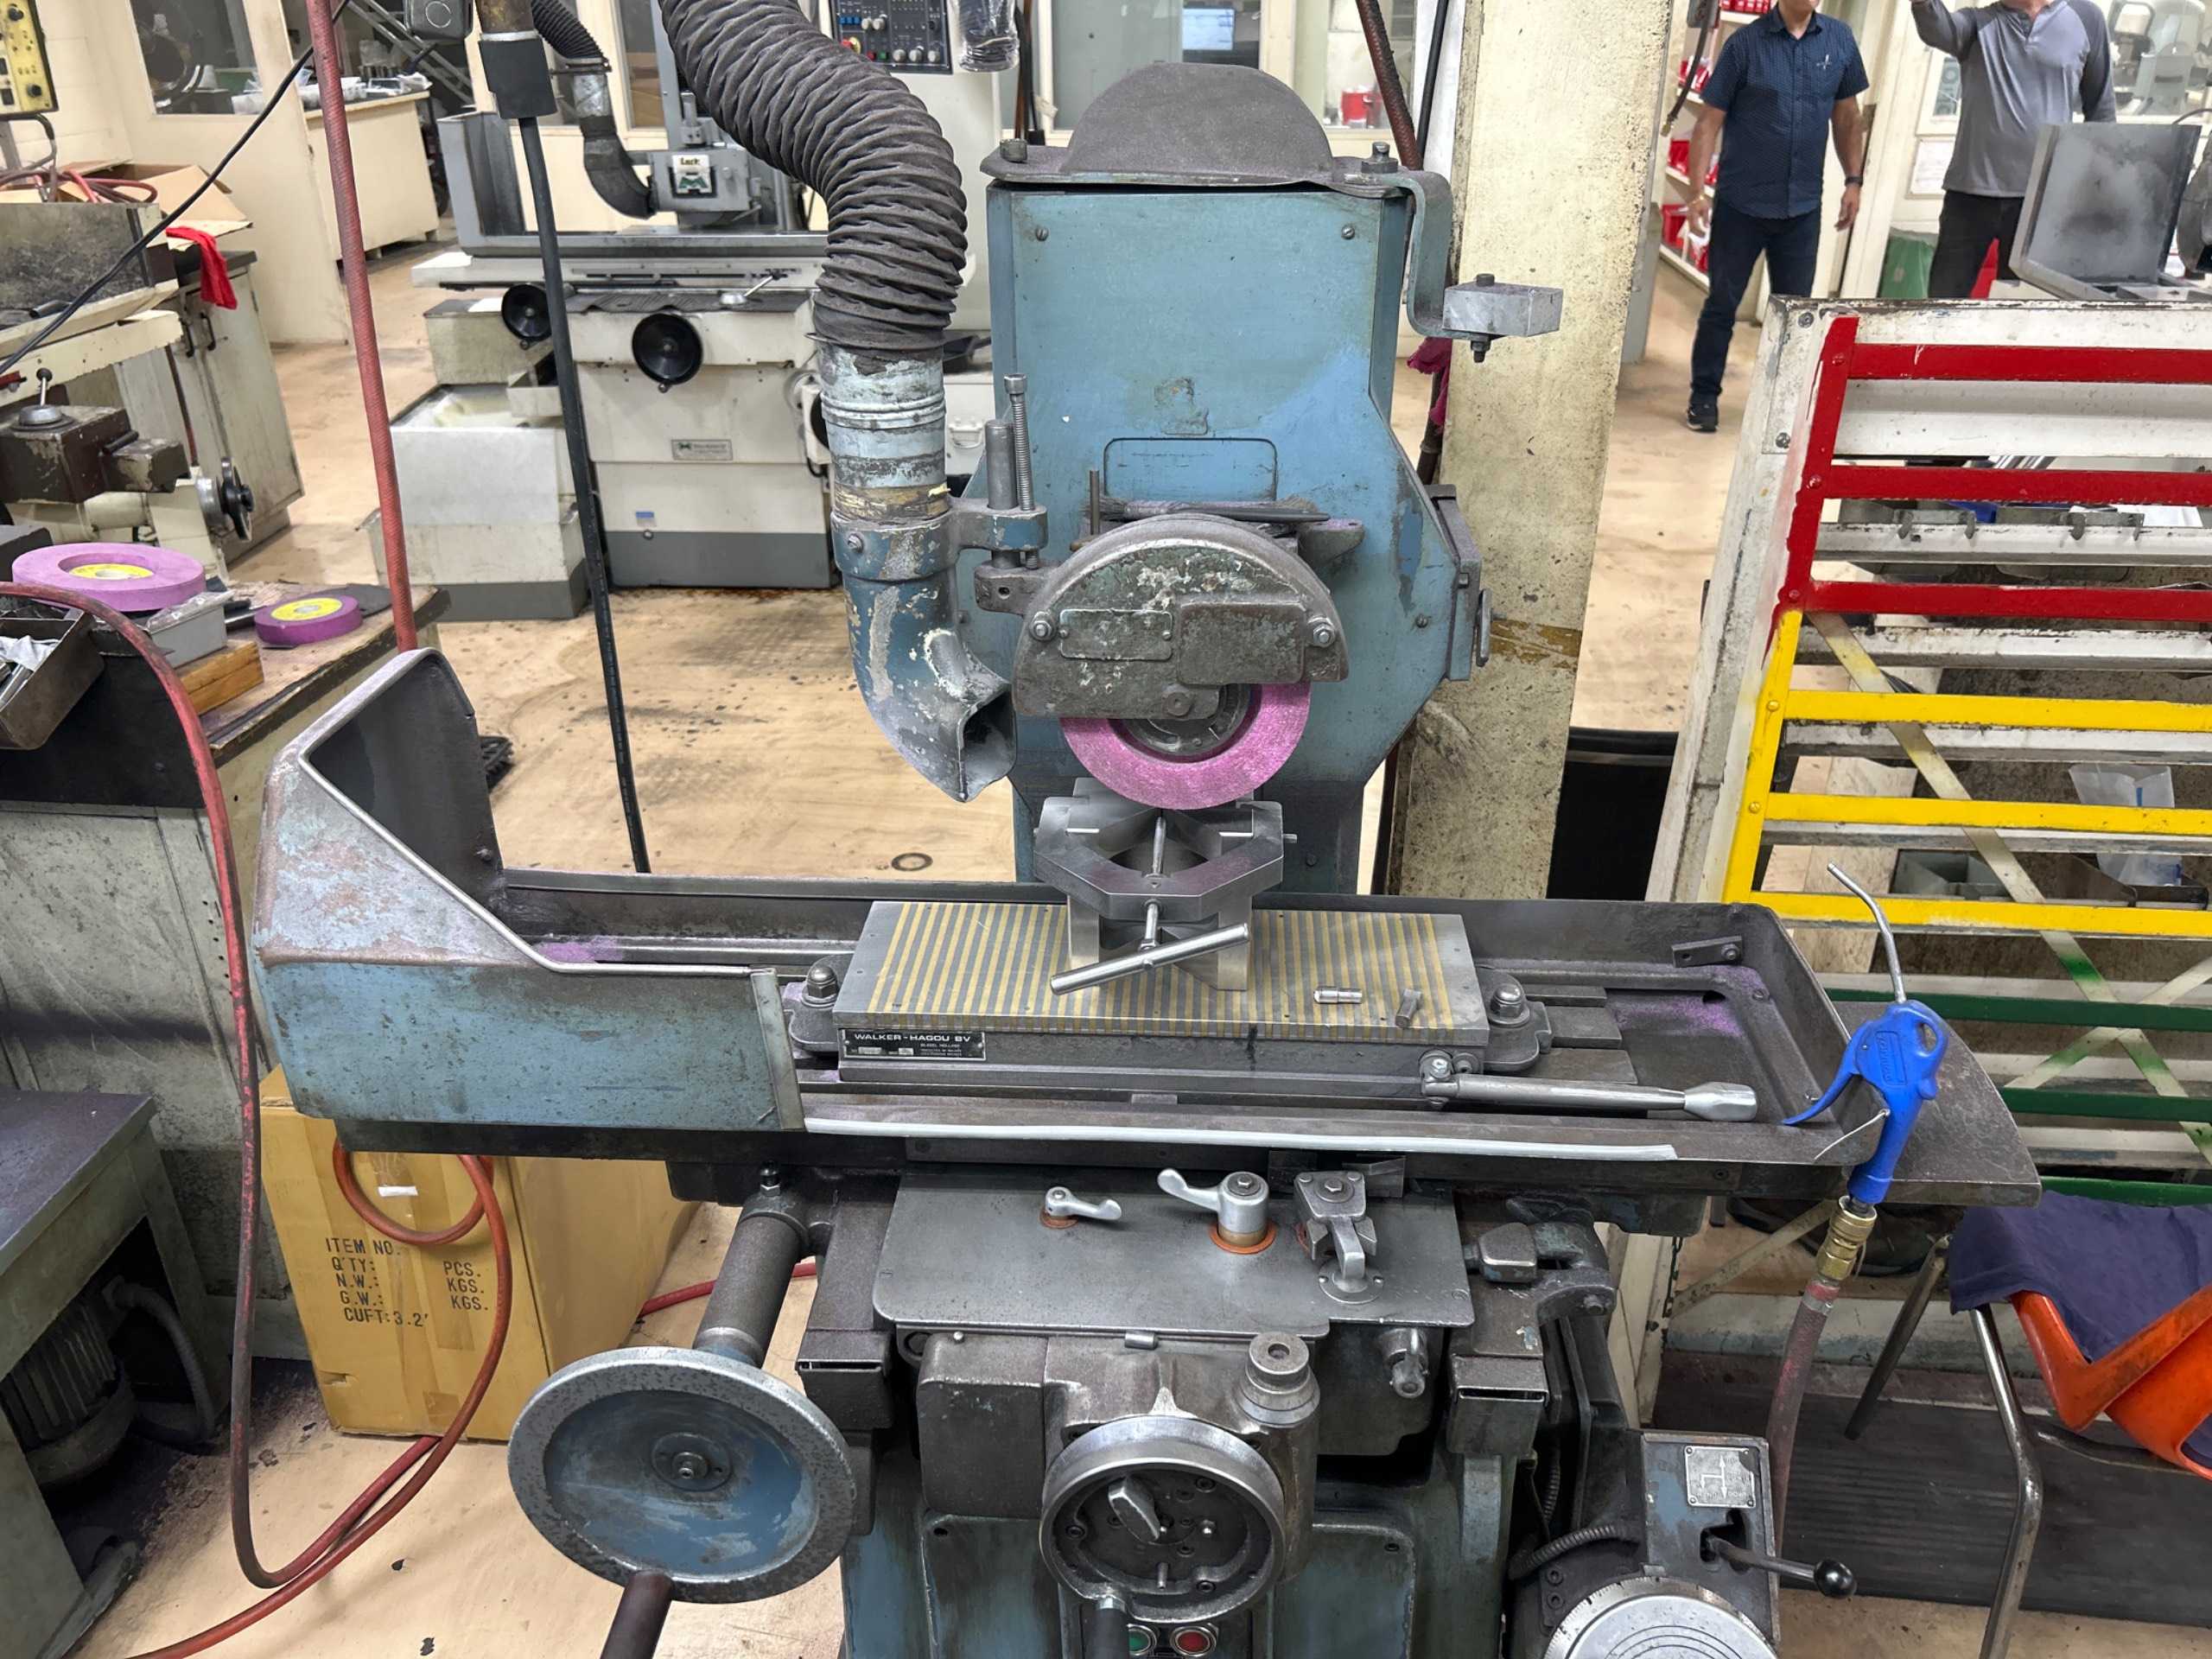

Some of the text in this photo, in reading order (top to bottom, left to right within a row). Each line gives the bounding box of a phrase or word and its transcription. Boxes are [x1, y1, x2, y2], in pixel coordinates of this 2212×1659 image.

[326, 1238, 401, 1255] ITEM NO.
[442, 1261, 481, 1278] PCS.
[335, 1274, 379, 1289] N.W.:
[447, 1277, 485, 1294] KGS.
[340, 1291, 384, 1306] G.W.:
[451, 1294, 489, 1312] KGS.
